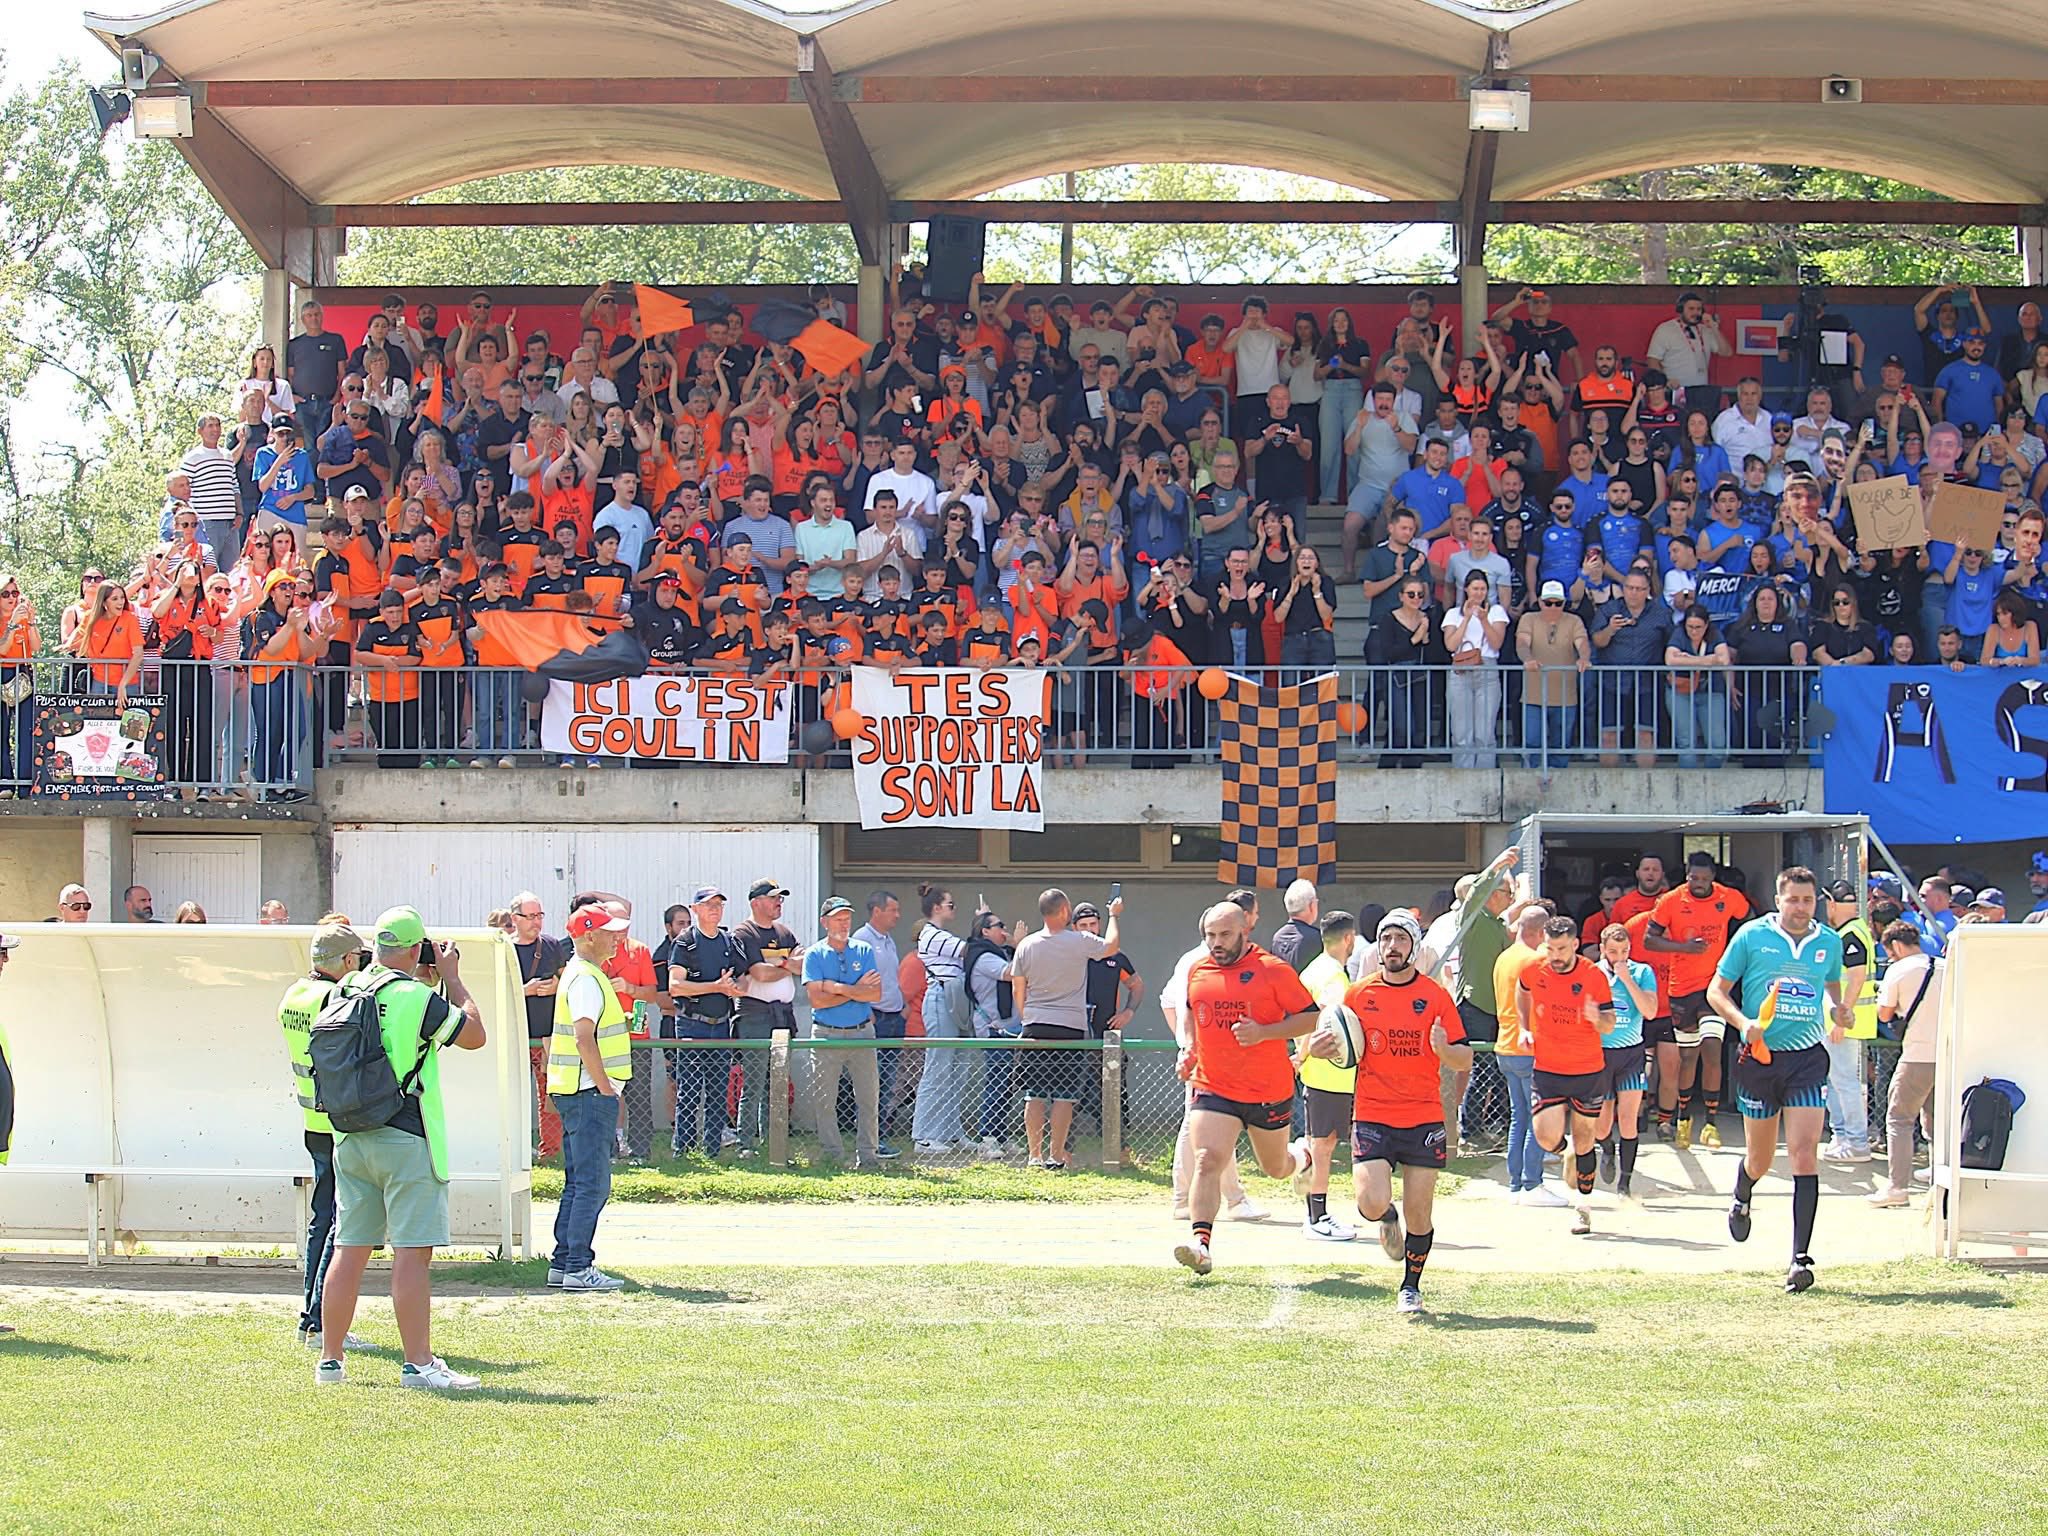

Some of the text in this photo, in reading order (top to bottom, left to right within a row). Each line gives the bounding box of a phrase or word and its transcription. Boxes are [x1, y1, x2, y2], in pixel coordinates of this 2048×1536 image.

[1900, 488, 1912, 500] DE
[1698, 576, 1741, 596] MERCI
[655, 676, 787, 720] C'EST
[893, 673, 1011, 716] TES
[857, 715, 1042, 764] SUPPORTERS
[881, 764, 1041, 823] SONT LA
[1215, 1001, 1246, 1010] BONS
[1389, 1029, 1422, 1039] BONS
[1389, 1039, 1420, 1047] PLANTS
[1390, 1047, 1420, 1057] VINS
